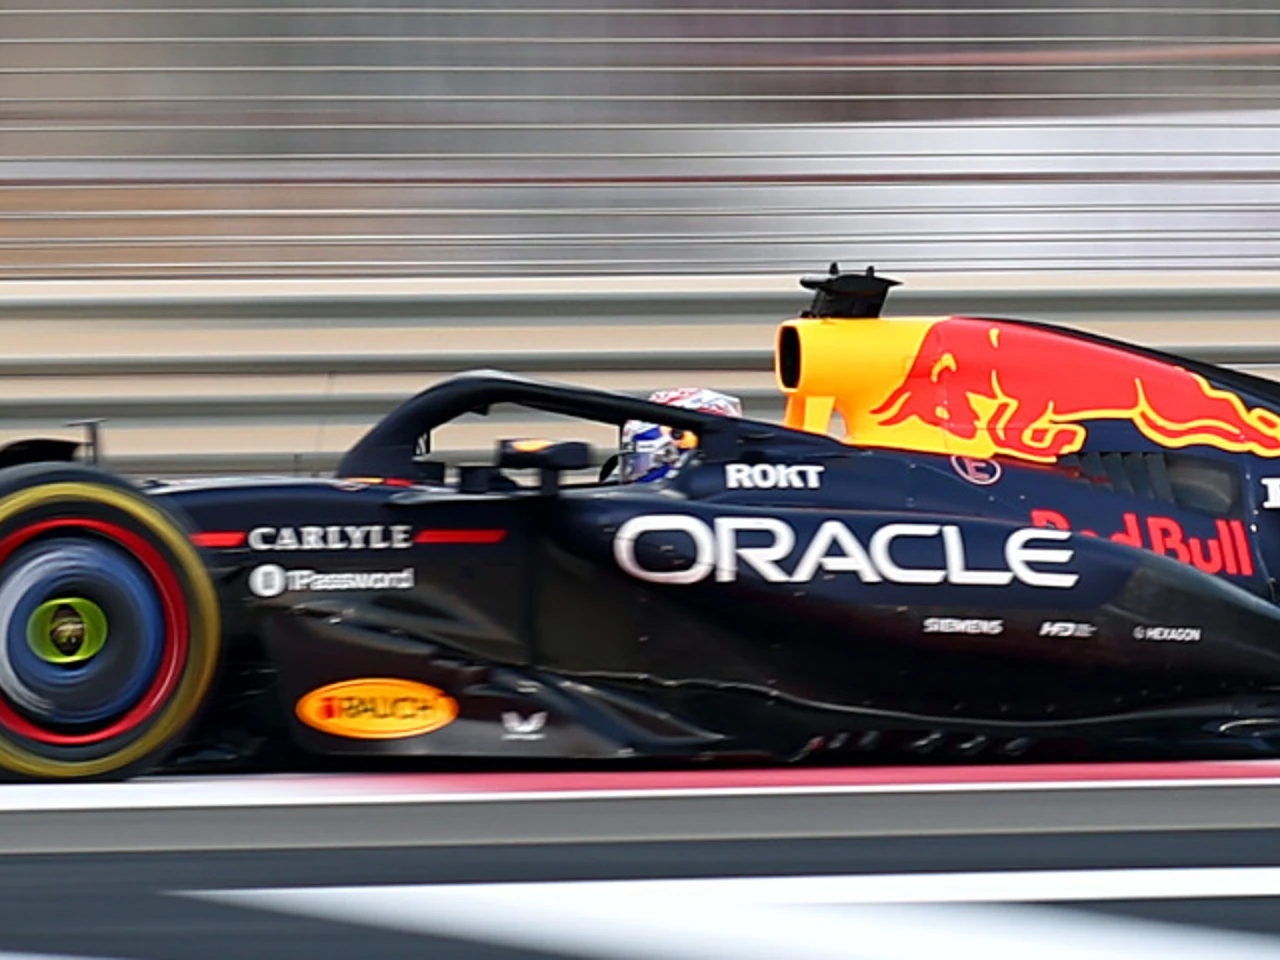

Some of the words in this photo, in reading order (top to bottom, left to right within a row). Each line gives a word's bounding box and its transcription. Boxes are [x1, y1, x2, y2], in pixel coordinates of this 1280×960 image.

[725, 464, 825, 489] ROKT
[248, 524, 414, 551] CARLYLE
[1145, 516, 1255, 577] Bull
[613, 514, 1081, 588] ORACLE
[923, 617, 1004, 635] SIEMENS
[1145, 627, 1201, 642] HEXAGON
